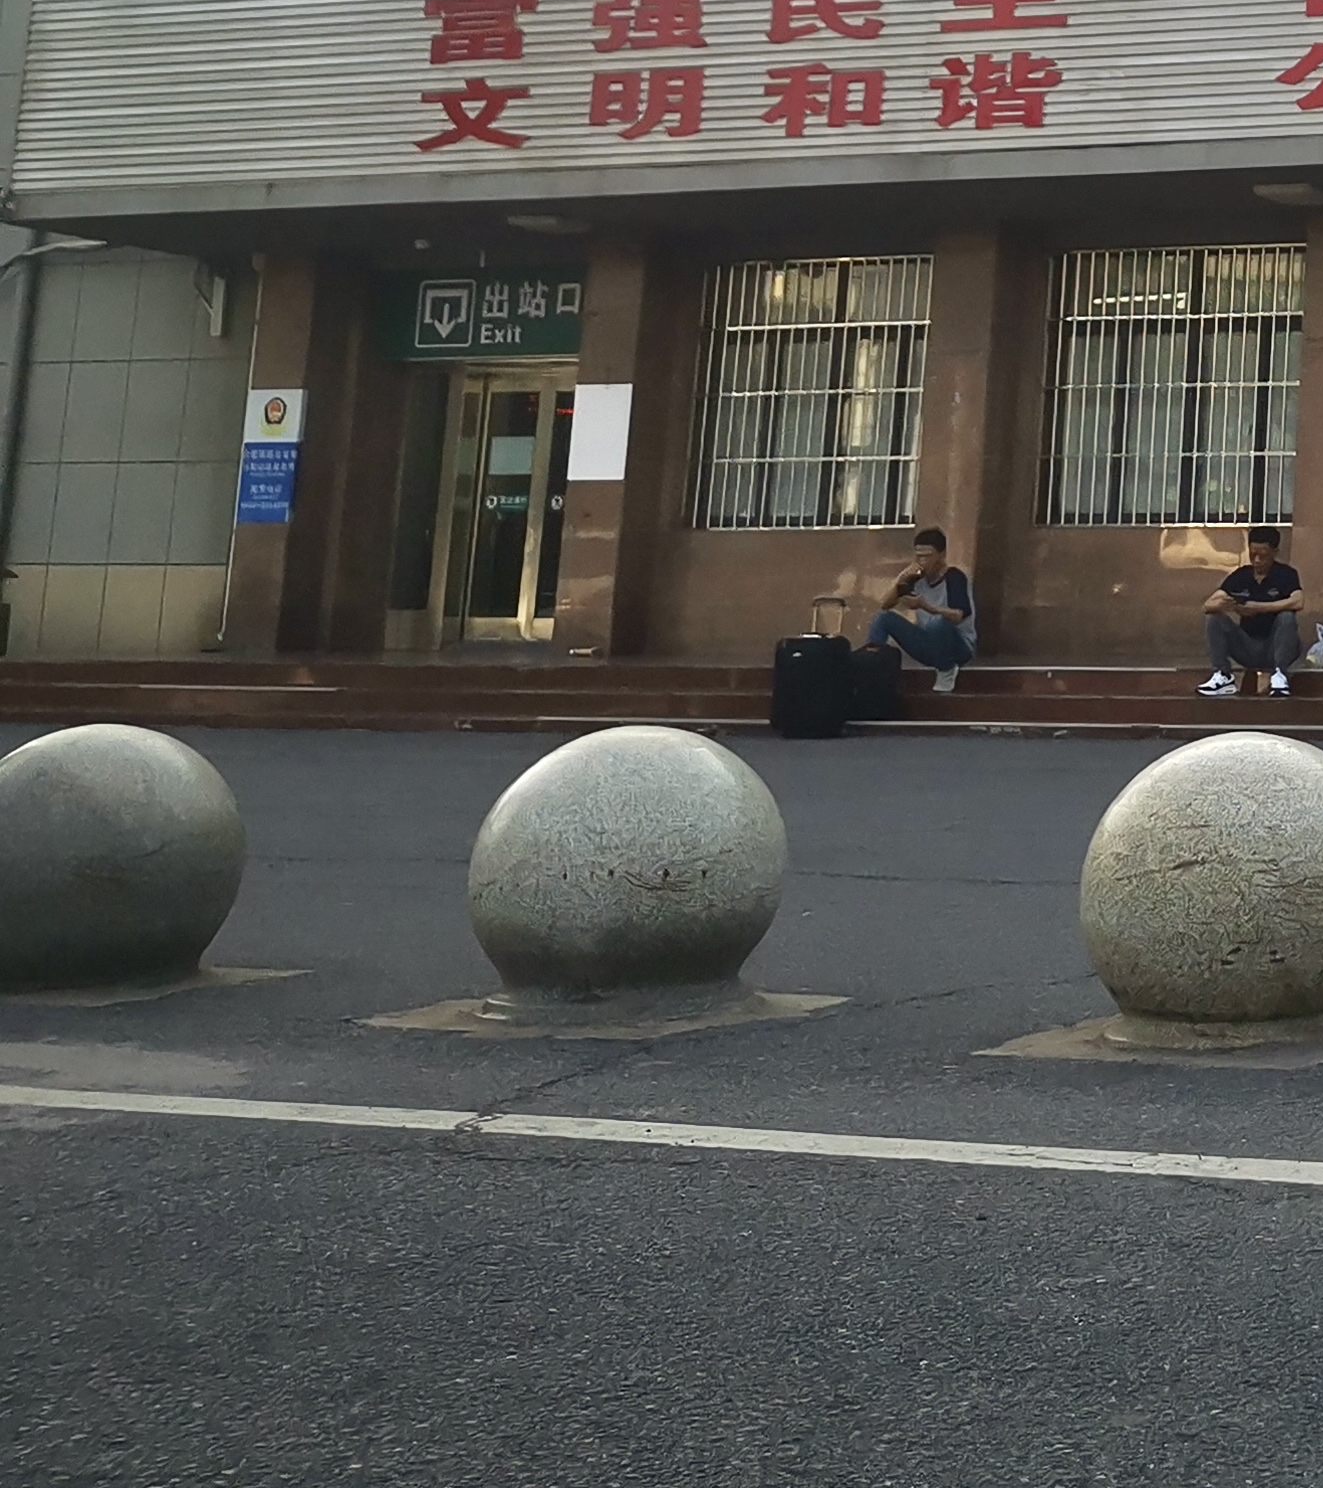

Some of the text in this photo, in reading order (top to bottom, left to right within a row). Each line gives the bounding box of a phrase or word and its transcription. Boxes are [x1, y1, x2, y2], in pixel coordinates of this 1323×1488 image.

[414, 52, 1064, 151] 文明和谐
[482, 280, 581, 318] 出站口
[480, 323, 522, 344] Exit
